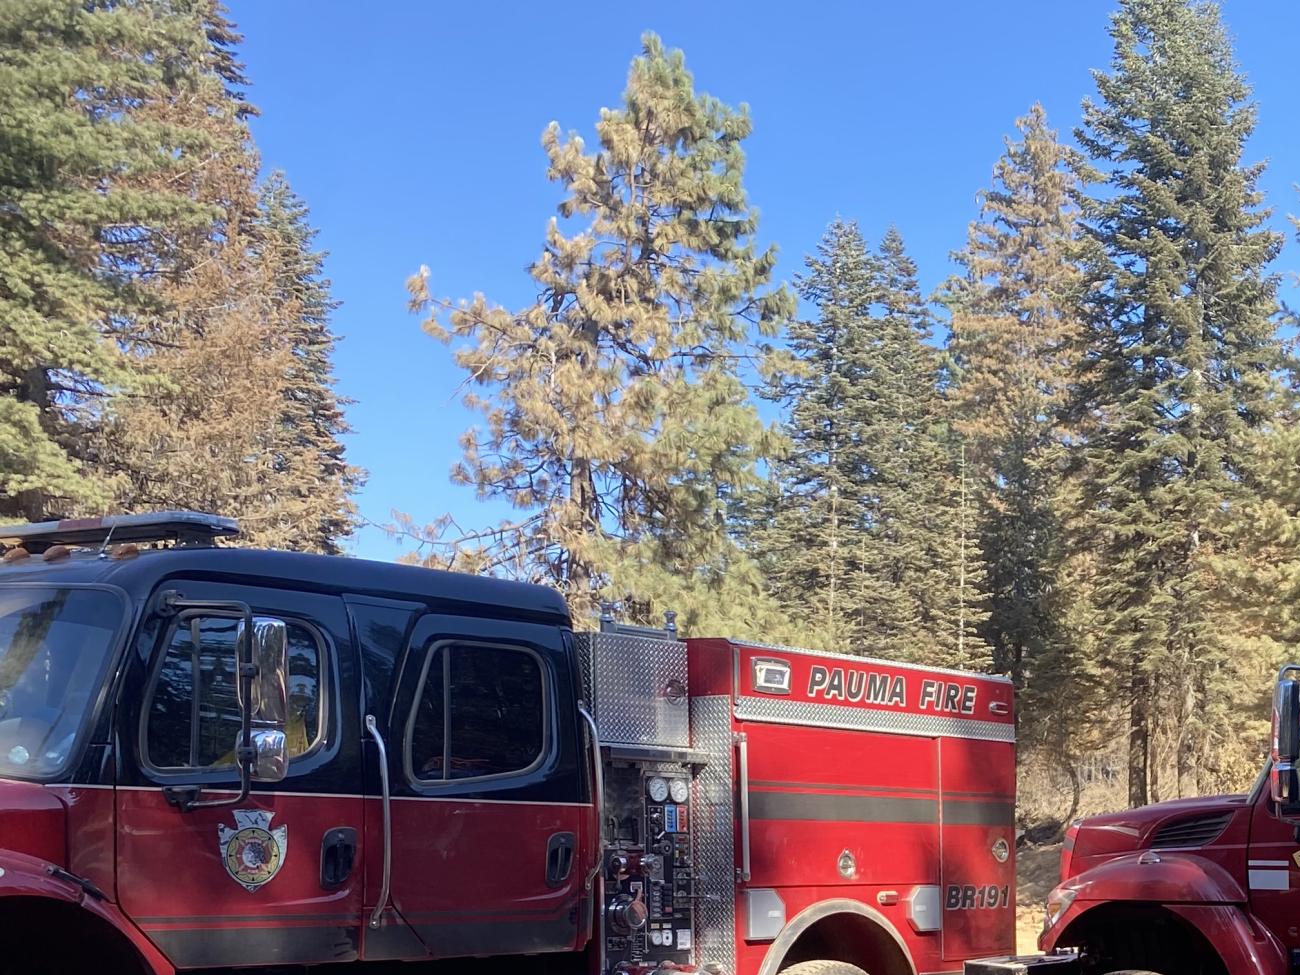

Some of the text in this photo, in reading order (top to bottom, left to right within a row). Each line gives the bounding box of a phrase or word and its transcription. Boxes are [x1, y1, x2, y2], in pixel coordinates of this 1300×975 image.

[808, 665, 977, 714] PAUMA FIRE
[945, 884, 1010, 910] BR191
